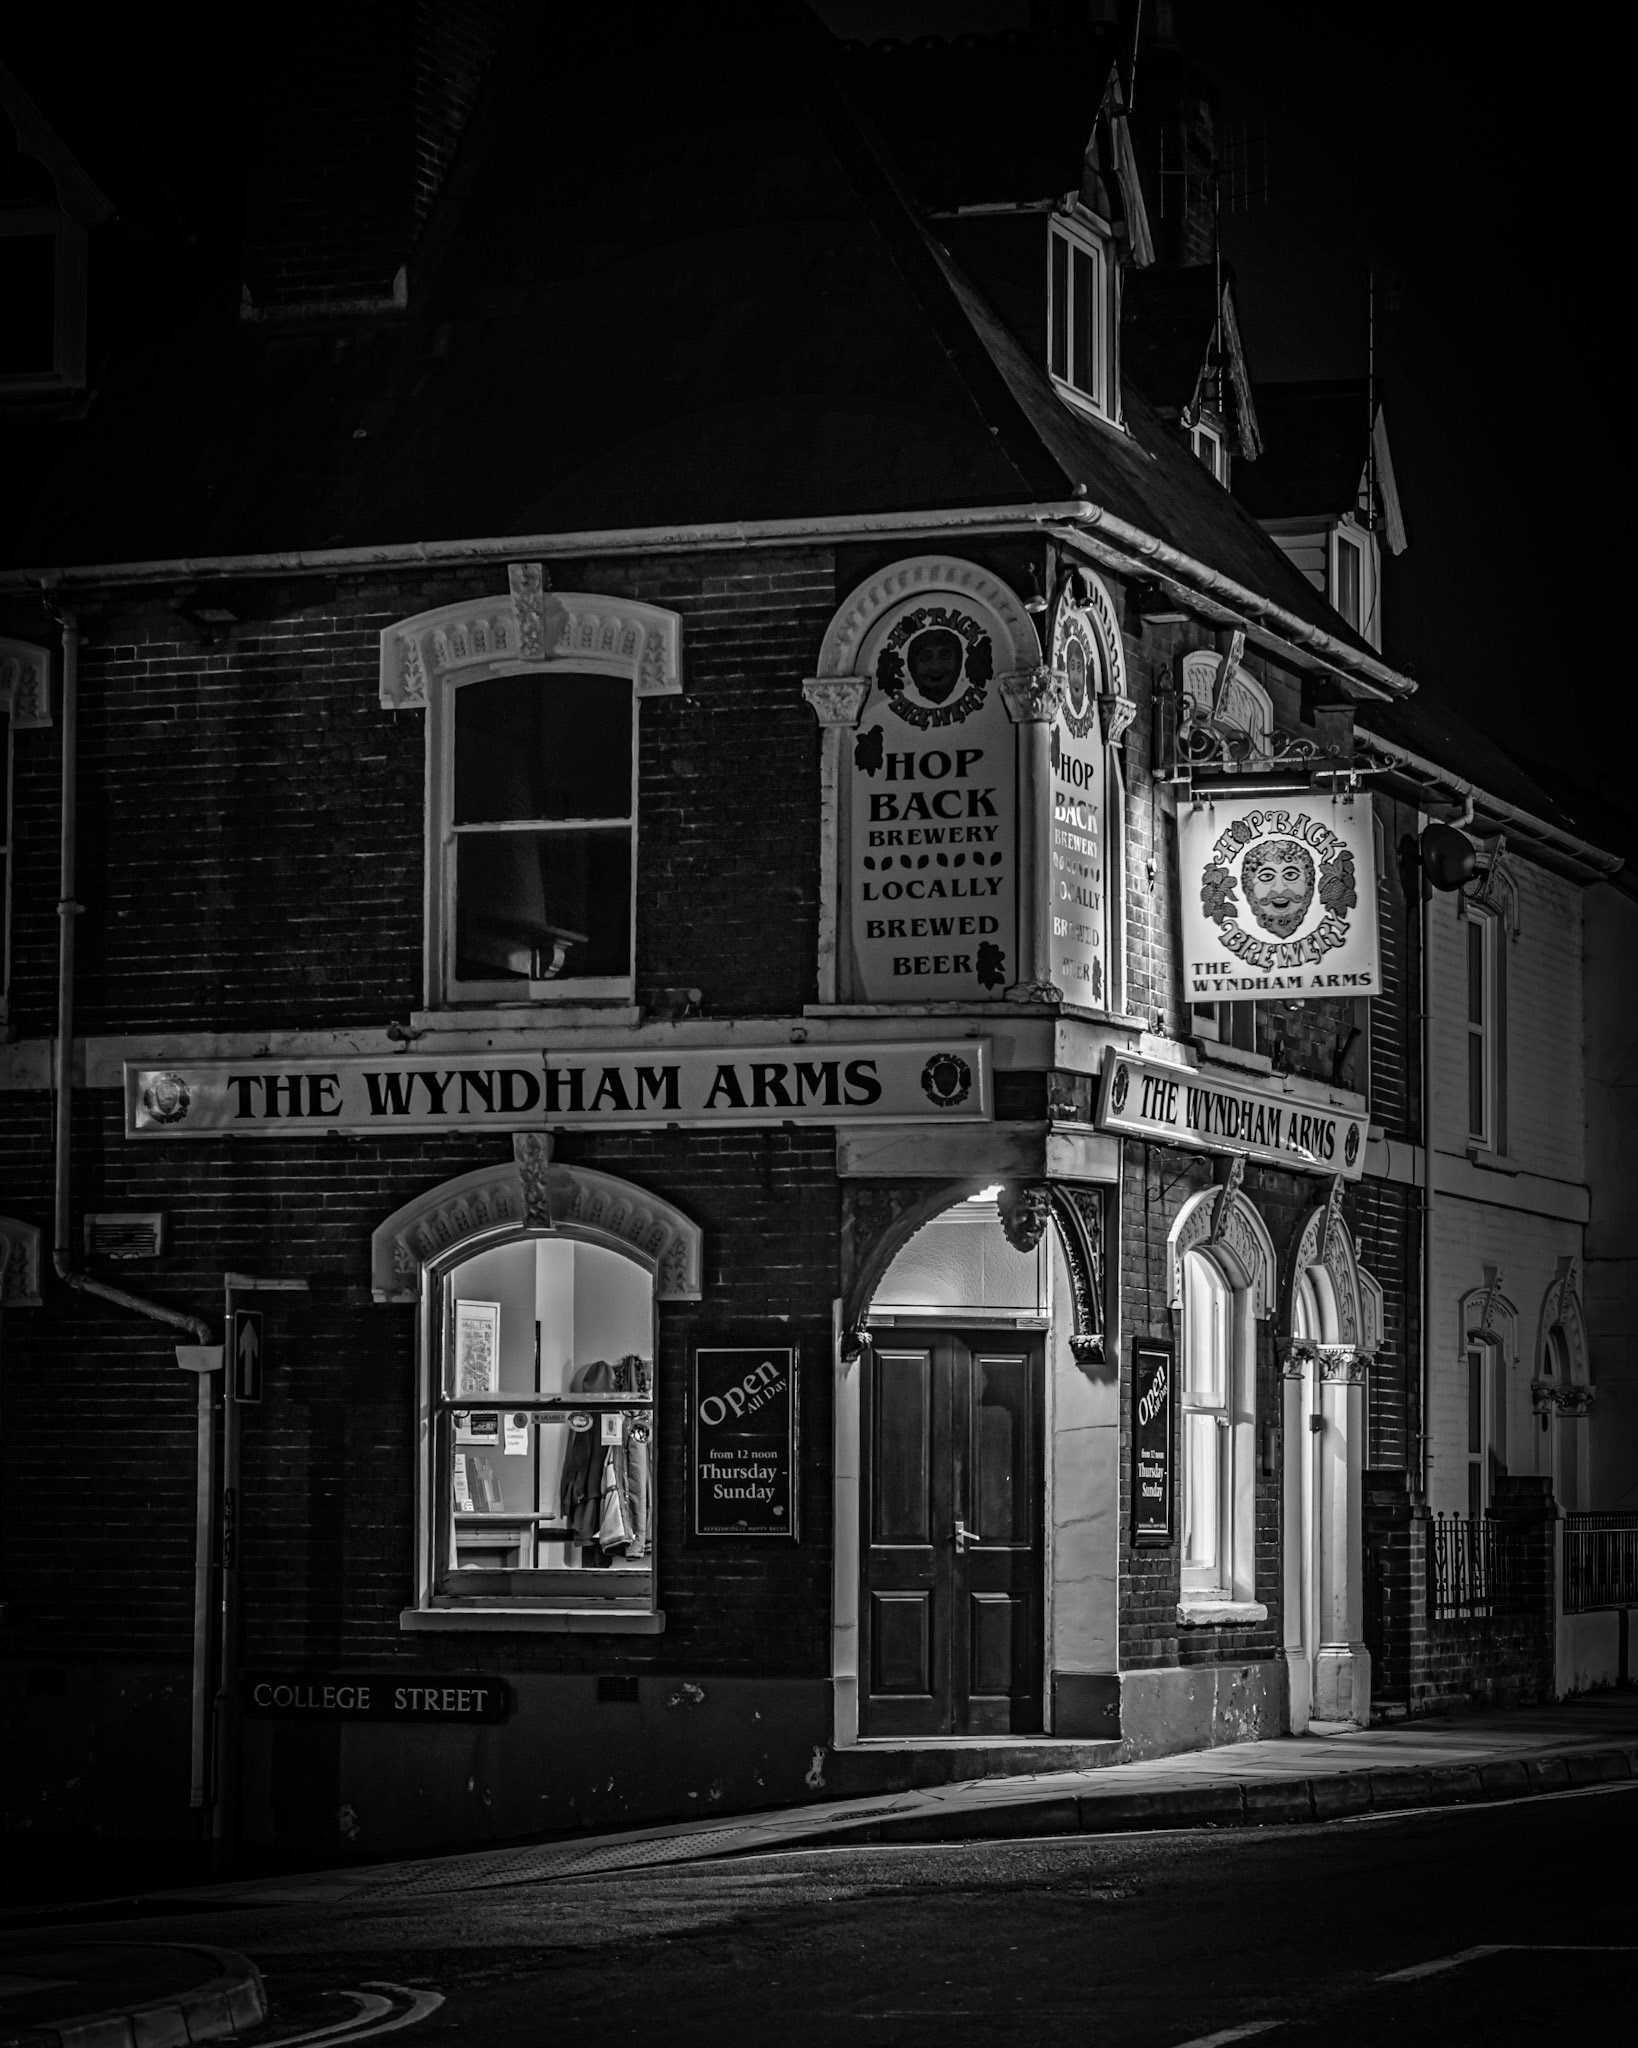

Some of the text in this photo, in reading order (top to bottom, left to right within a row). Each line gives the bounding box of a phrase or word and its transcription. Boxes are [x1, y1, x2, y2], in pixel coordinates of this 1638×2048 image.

[888, 682, 988, 731] BREWERY
[885, 749, 984, 781] HOP
[1060, 752, 1095, 791] HOP
[869, 788, 999, 822] BACK
[1054, 791, 1099, 835] BACK
[869, 825, 999, 847] BREWERY
[1054, 828, 1099, 859] BREWERY
[863, 877, 1004, 901] LOCALLY
[1052, 878, 1101, 911] LOCALLY
[866, 916, 999, 939] BREWED
[1218, 910, 1350, 973] BREWERY
[893, 955, 973, 976] BEER
[1192, 962, 1232, 975] THE
[1192, 972, 1373, 992] WYNDHAM ARMS
[227, 1060, 883, 1119] THE WYNDHAM ARMS
[1140, 1074, 1180, 1125] THE
[1186, 1086, 1283, 1149] WYNDHAM
[1286, 1112, 1336, 1161] ARMS
[700, 1360, 780, 1426] Open
[747, 1378, 788, 1415] All Day
[1138, 1365, 1166, 1426] Open
[709, 1449, 778, 1459] from 12 noon
[699, 1463, 777, 1483] Thursday
[1138, 1462, 1164, 1482] Thursday
[713, 1483, 775, 1503] Sunday
[1142, 1482, 1163, 1502] Sunday
[253, 1683, 489, 1713] COLLEGE STREET
